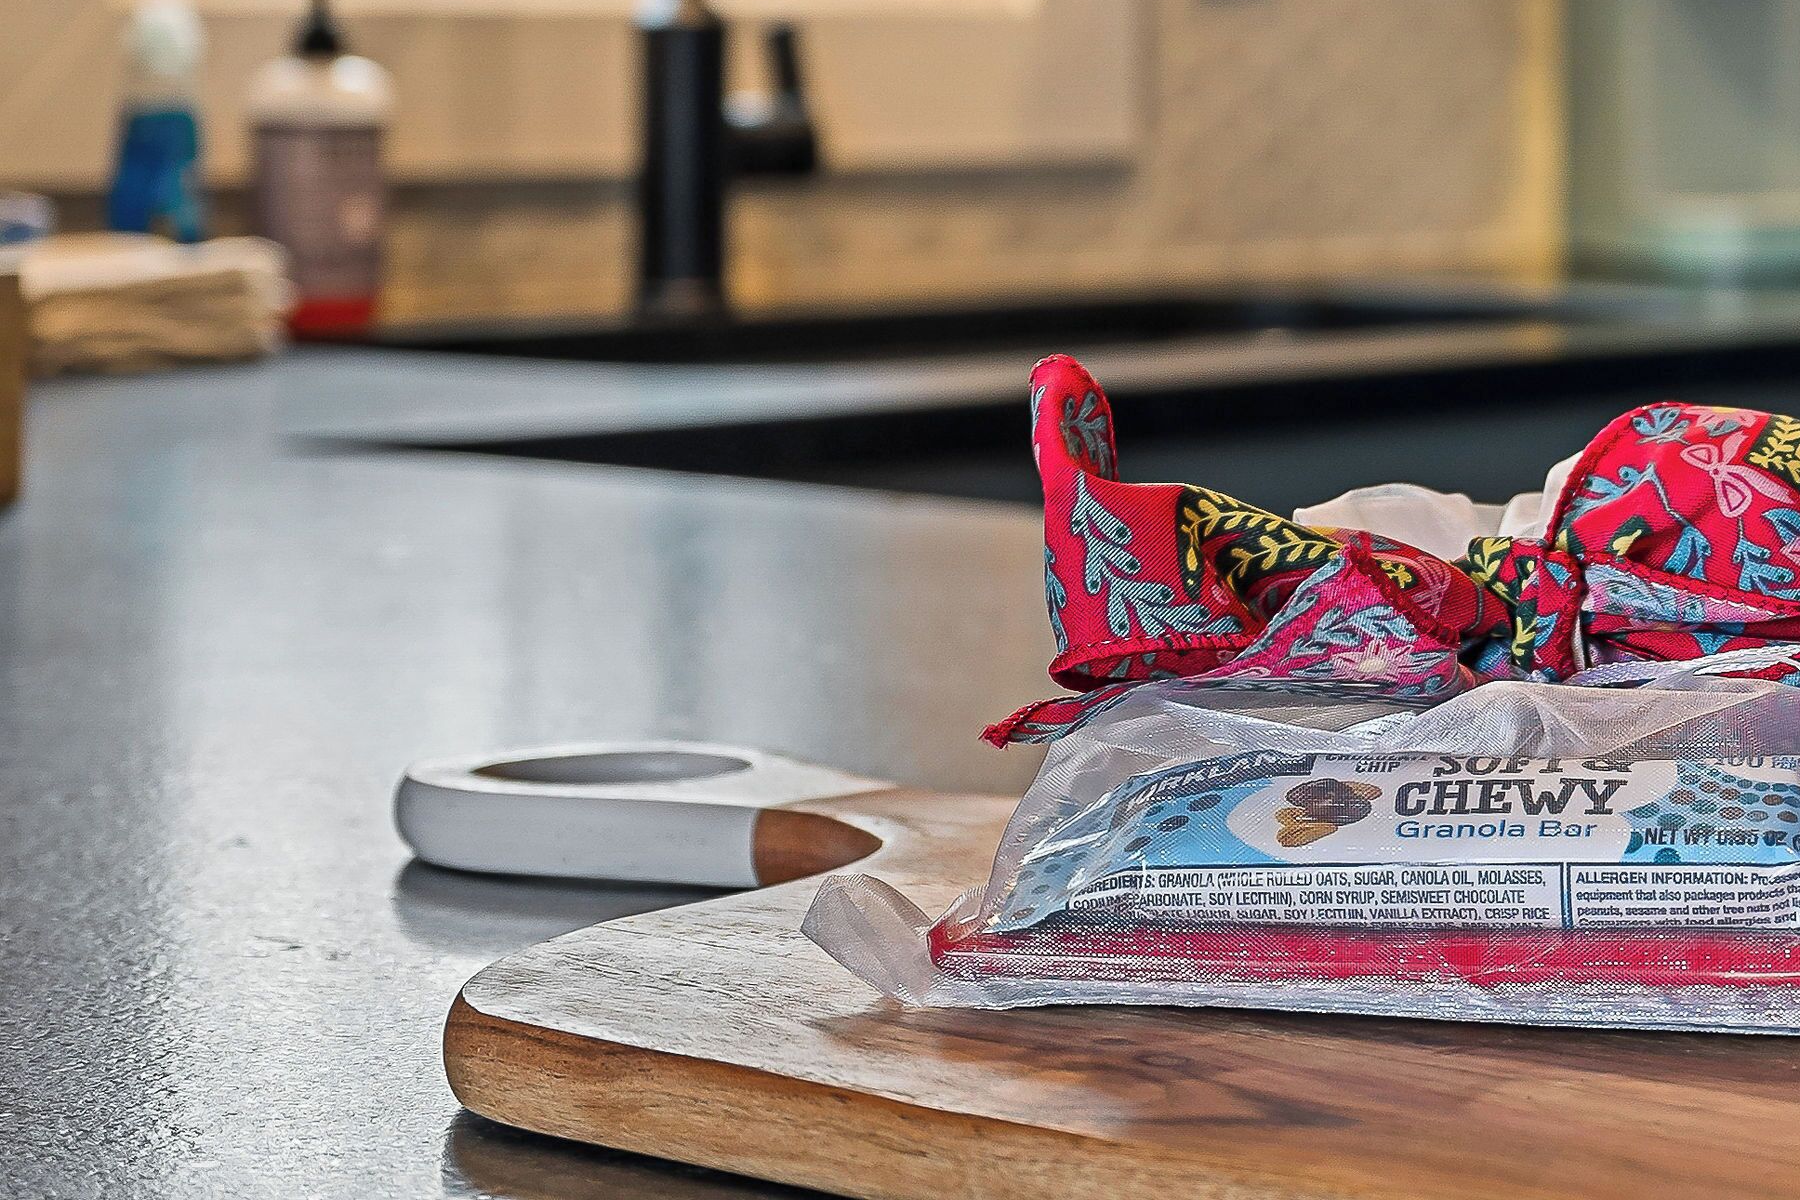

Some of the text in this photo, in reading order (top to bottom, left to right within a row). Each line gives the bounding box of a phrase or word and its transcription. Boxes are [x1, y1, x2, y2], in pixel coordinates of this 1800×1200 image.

[1355, 760, 1400, 773] CHIP
[1395, 778, 1628, 816] CHEWY
[1395, 819, 1598, 839] Granola Bar
[1644, 828, 1678, 845] NET
[1684, 829, 1711, 845] WT
[1158, 872, 1214, 888] GRANOLA
[1267, 871, 1312, 887] ROLLED
[1316, 871, 1350, 888] OATS,
[1354, 871, 1398, 888] SUGAR,
[1401, 870, 1449, 885] CANOLA
[1452, 870, 1474, 887] OIL,
[1478, 870, 1546, 887] MOLASSES,
[1576, 871, 1647, 884] ALLERGEN
[1652, 871, 1748, 885] INFORMATION:
[1209, 891, 1233, 906] SOY
[1300, 891, 1332, 905] CORN
[1336, 891, 1378, 906] SYRUP,
[1381, 890, 1450, 905] SEMISWEET
[1454, 890, 1525, 904] CHOCOLATE
[1576, 888, 1633, 902] equipment
[1635, 888, 1657, 900] that
[1660, 888, 1681, 901] also
[1684, 888, 1735, 903] packages
[1738, 886, 1785, 902] products
[1284, 909, 1308, 920] SOY
[1369, 908, 1418, 920] VANILLA
[1485, 908, 1519, 920] CRISP
[1523, 908, 1549, 920] RICE
[1625, 906, 1667, 916] sesame
[1669, 905, 1690, 915] and
[1692, 904, 1720, 915] other
[1722, 904, 1744, 914] tree
[1747, 903, 1770, 914] nuts
[1772, 899, 1790, 912] not
[1773, 911, 1797, 924] and
